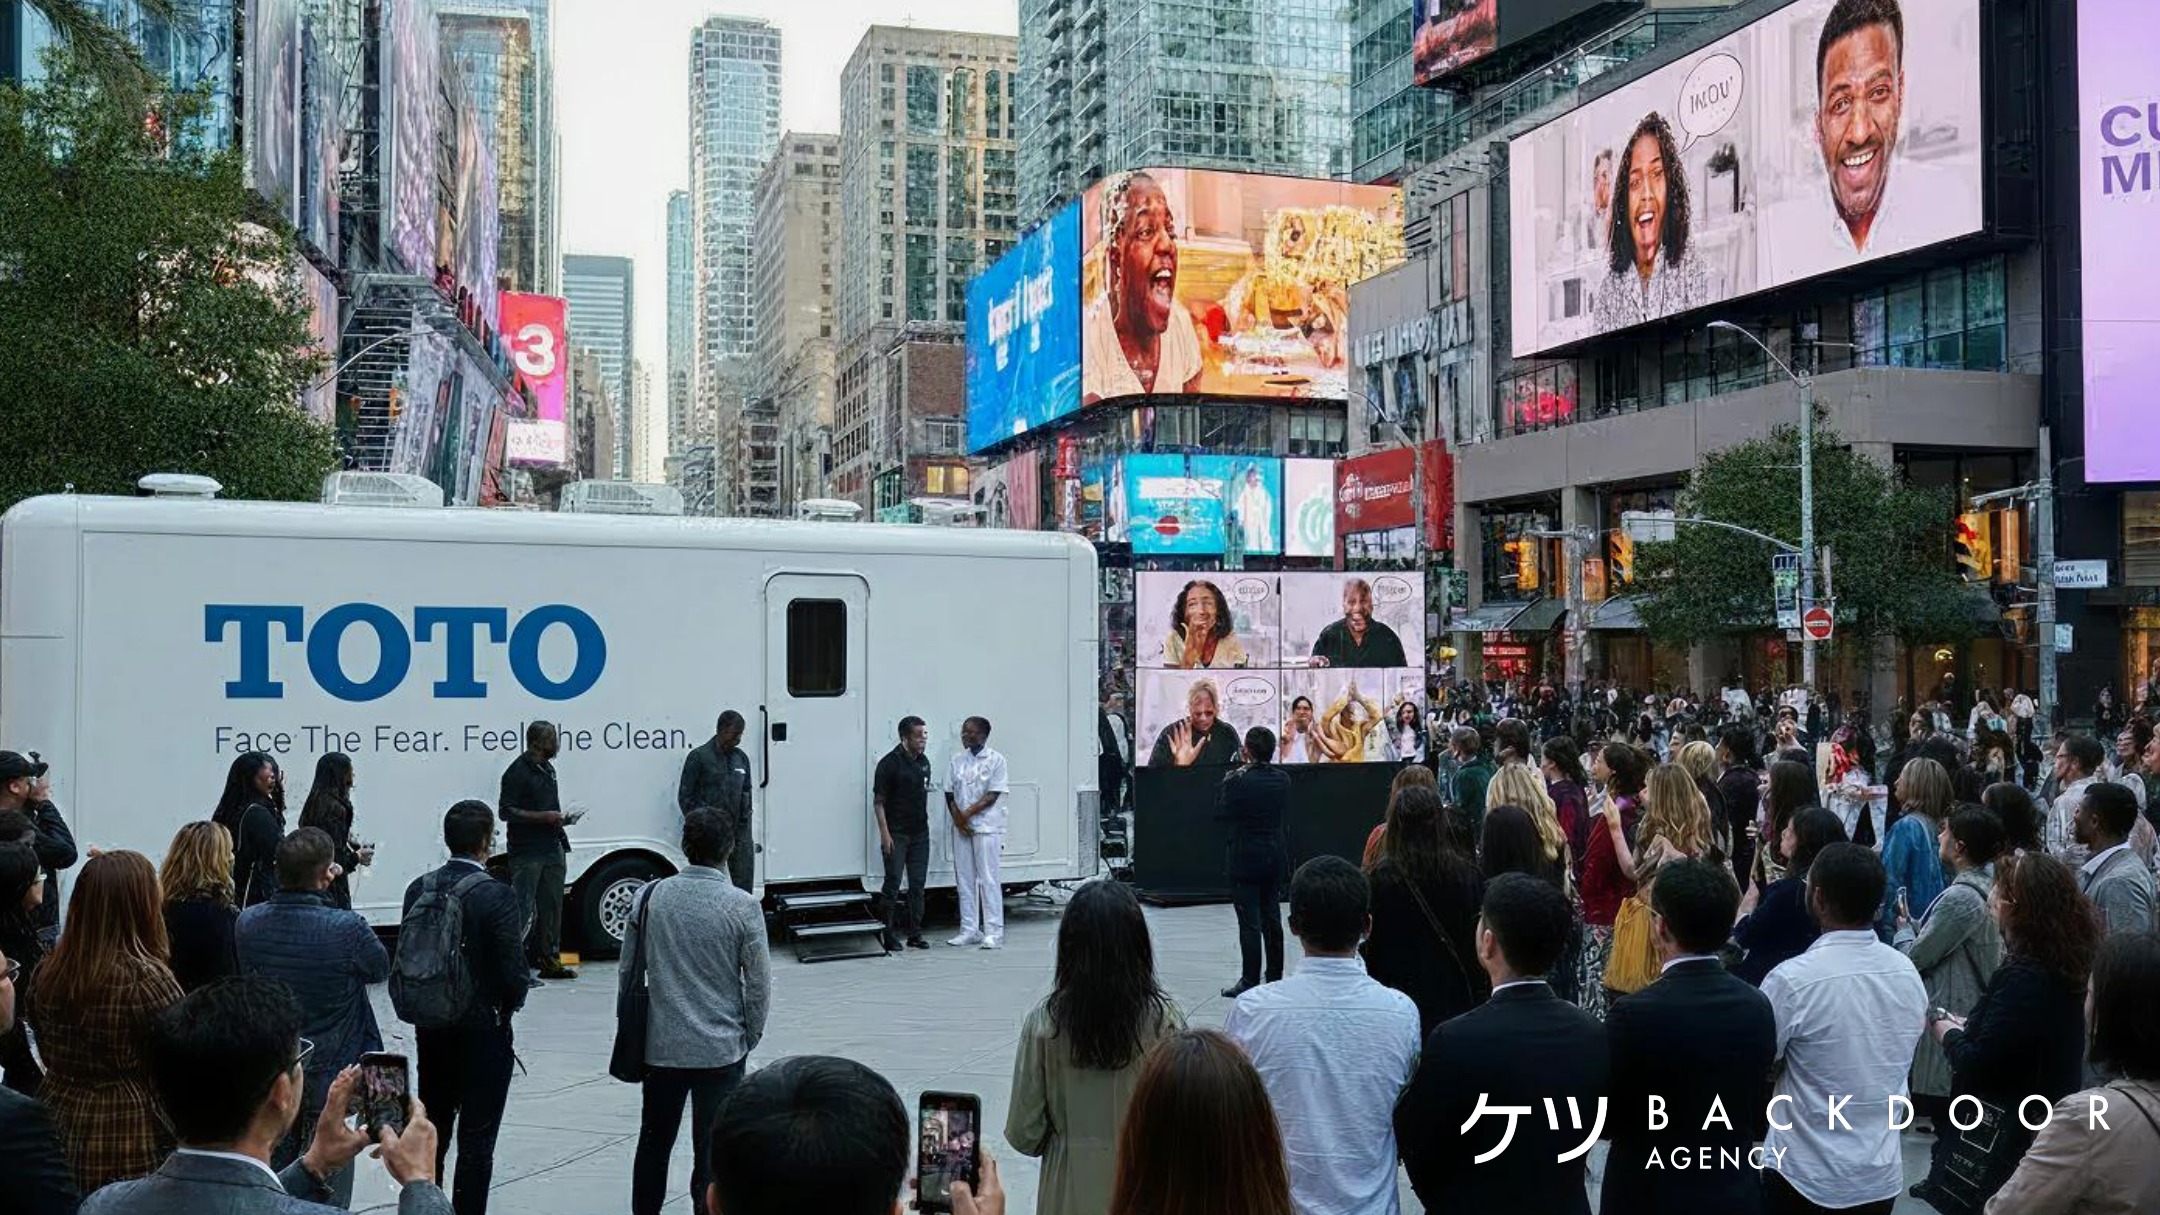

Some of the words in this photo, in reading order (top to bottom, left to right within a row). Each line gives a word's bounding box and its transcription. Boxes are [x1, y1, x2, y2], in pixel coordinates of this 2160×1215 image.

[515, 323, 556, 377] 3
[205, 602, 607, 702] TOTO
[215, 726, 292, 754] Face
[301, 724, 361, 753] The
[376, 725, 449, 753] Fear.
[464, 721, 525, 753] Feel
[557, 723, 593, 751] he
[603, 722, 693, 750] Clean.
